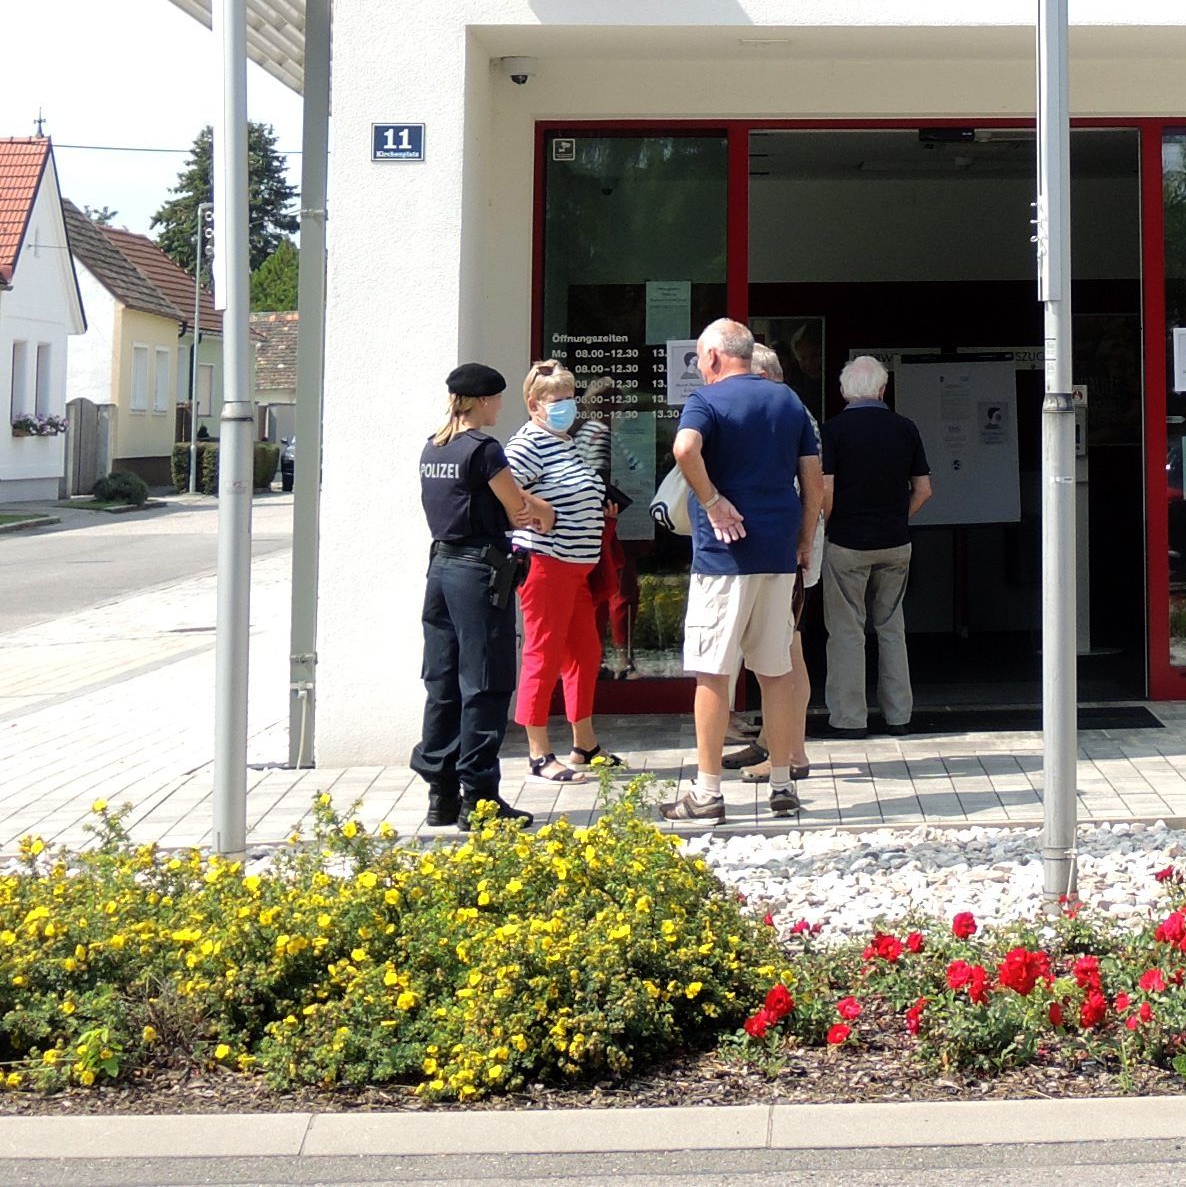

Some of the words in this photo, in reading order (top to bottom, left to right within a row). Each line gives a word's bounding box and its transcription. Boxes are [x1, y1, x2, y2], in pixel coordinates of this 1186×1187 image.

[383, 128, 412, 149] 11
[552, 332, 628, 345] Öffnungszeiten
[551, 349, 567, 358] Mo
[420, 463, 459, 479] POLIZEI
